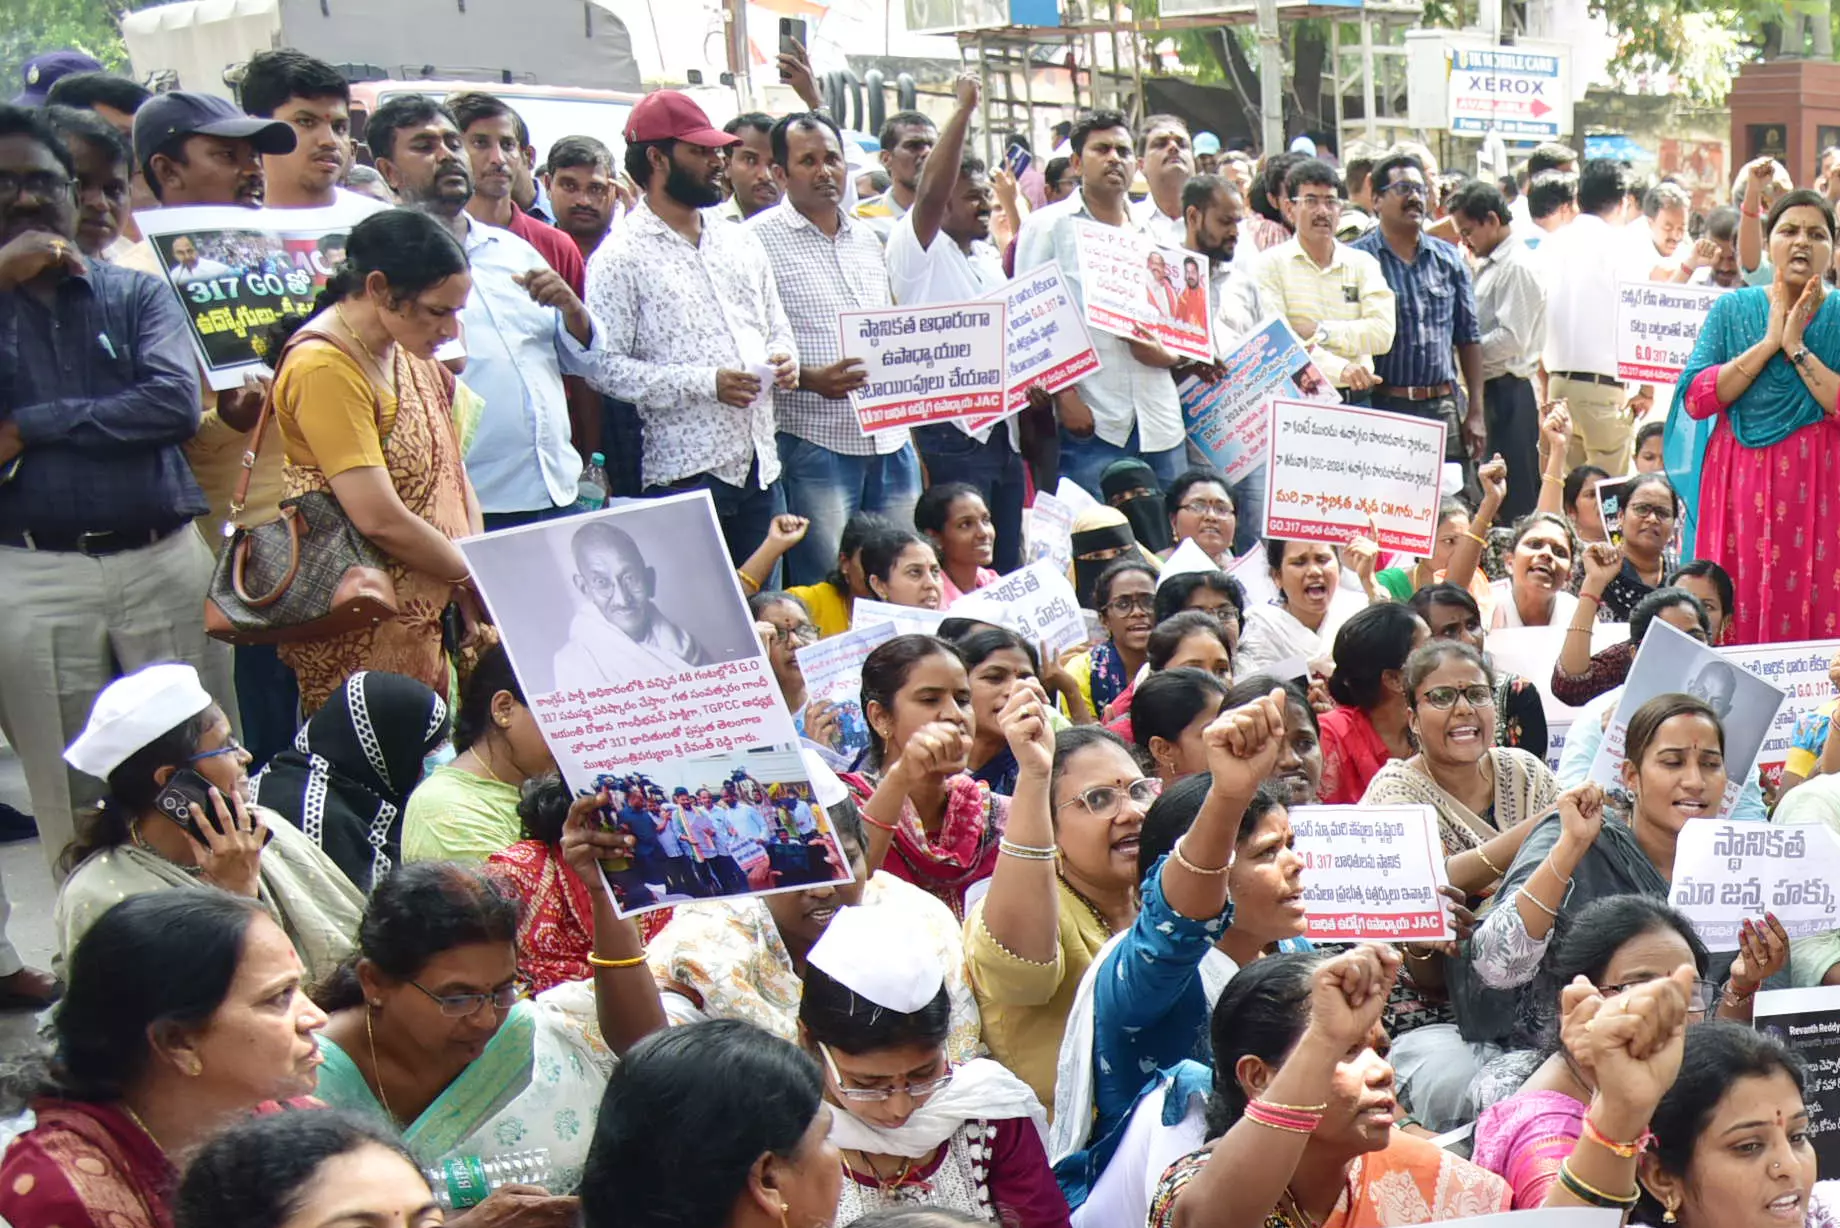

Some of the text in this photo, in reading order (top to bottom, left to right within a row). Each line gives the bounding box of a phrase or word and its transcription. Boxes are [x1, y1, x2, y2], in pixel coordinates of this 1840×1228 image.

[1469, 76, 1544, 95] XEROX
[187, 278, 239, 303] 317
[246, 274, 284, 296] GO
[860, 312, 990, 347] స్థానికత ఆధారంగా
[882, 343, 971, 368] ఉపాధ్యాయుల
[949, 367, 1000, 388] చేయాలి
[974, 395, 1000, 407] JAC
[1276, 488, 1299, 503] మరి
[1301, 492, 1314, 505] నా
[1270, 519, 1300, 533] GO.317
[1714, 826, 1806, 873] స్థానికత
[1317, 854, 1332, 869] 317
[1676, 877, 1836, 914] మా జన్మ హక్కు
[1412, 916, 1439, 929] JAC
[1789, 1022, 1840, 1036] Revanth Reddy
